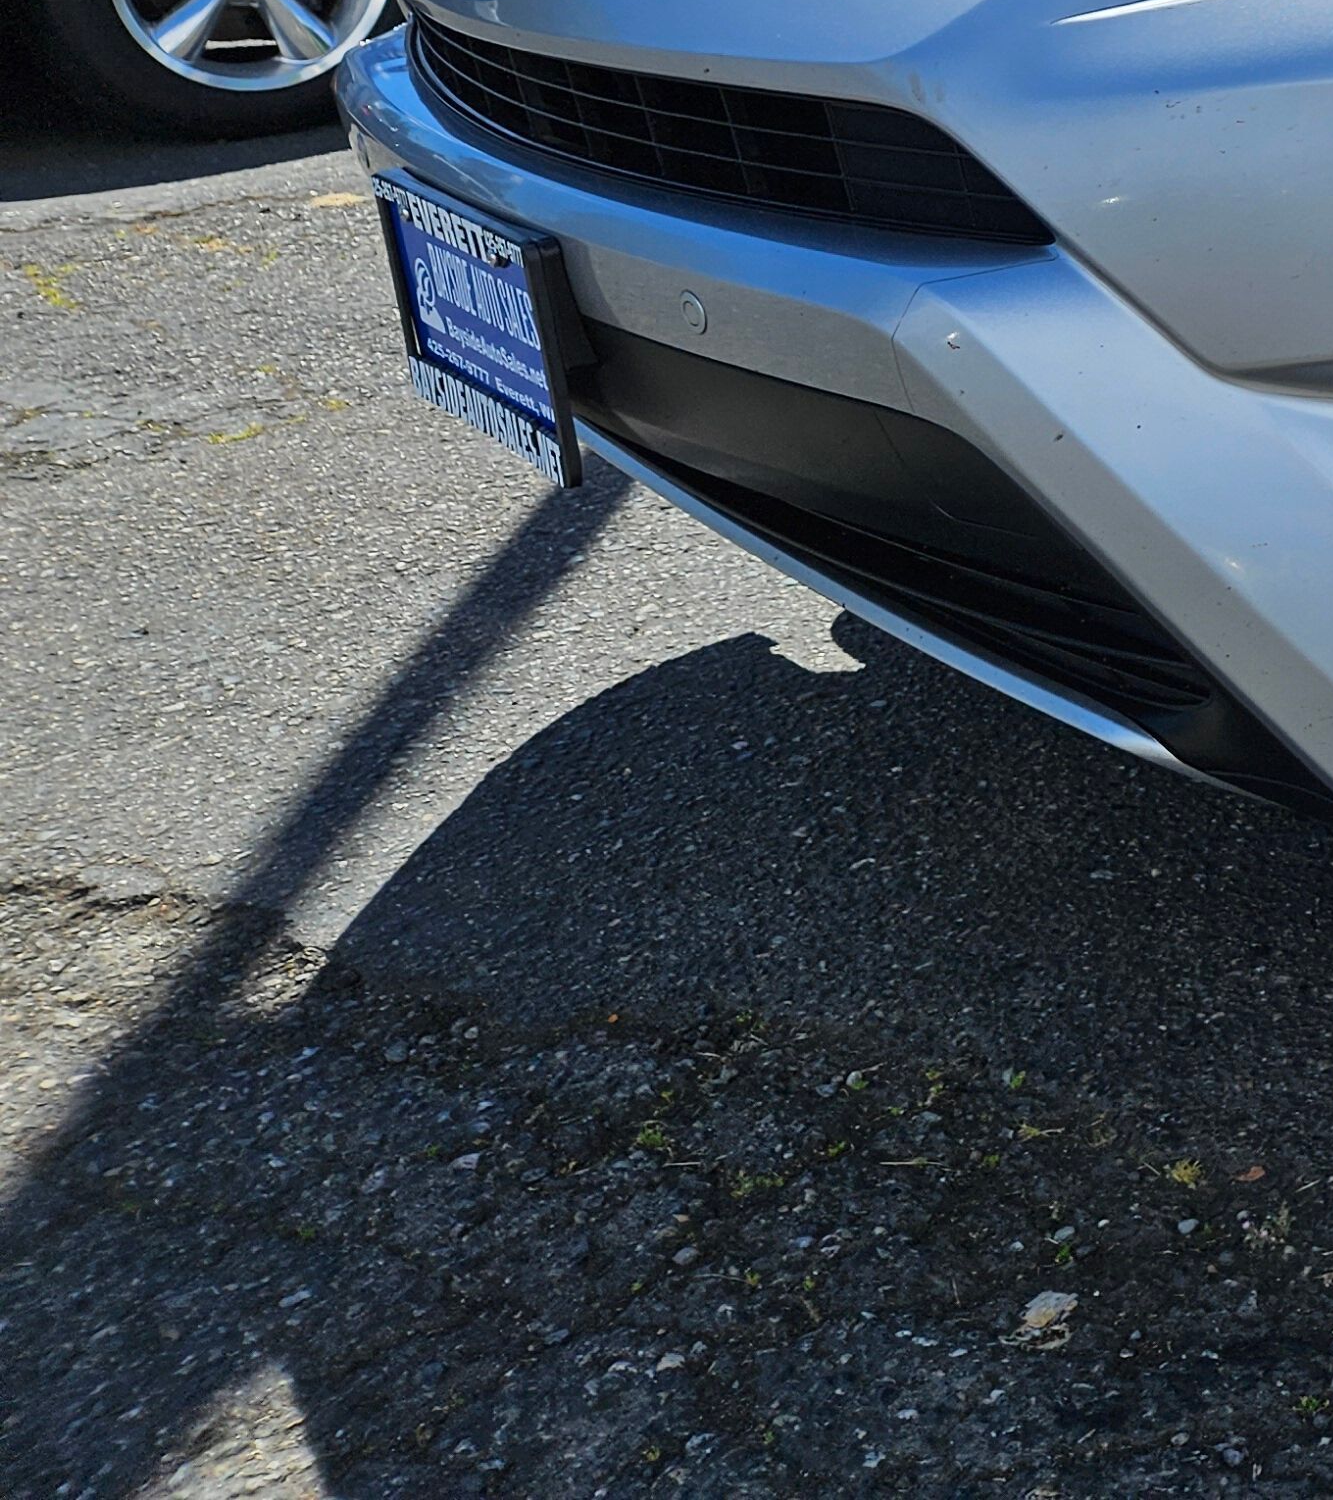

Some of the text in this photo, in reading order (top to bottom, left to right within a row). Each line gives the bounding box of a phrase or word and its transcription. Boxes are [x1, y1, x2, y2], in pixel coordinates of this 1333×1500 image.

[406, 191, 490, 265] EVERETT
[426, 242, 541, 351] BAYSIDE AUTO SALES
[408, 355, 565, 489] BAYSIDEAUTOSALES.NET
